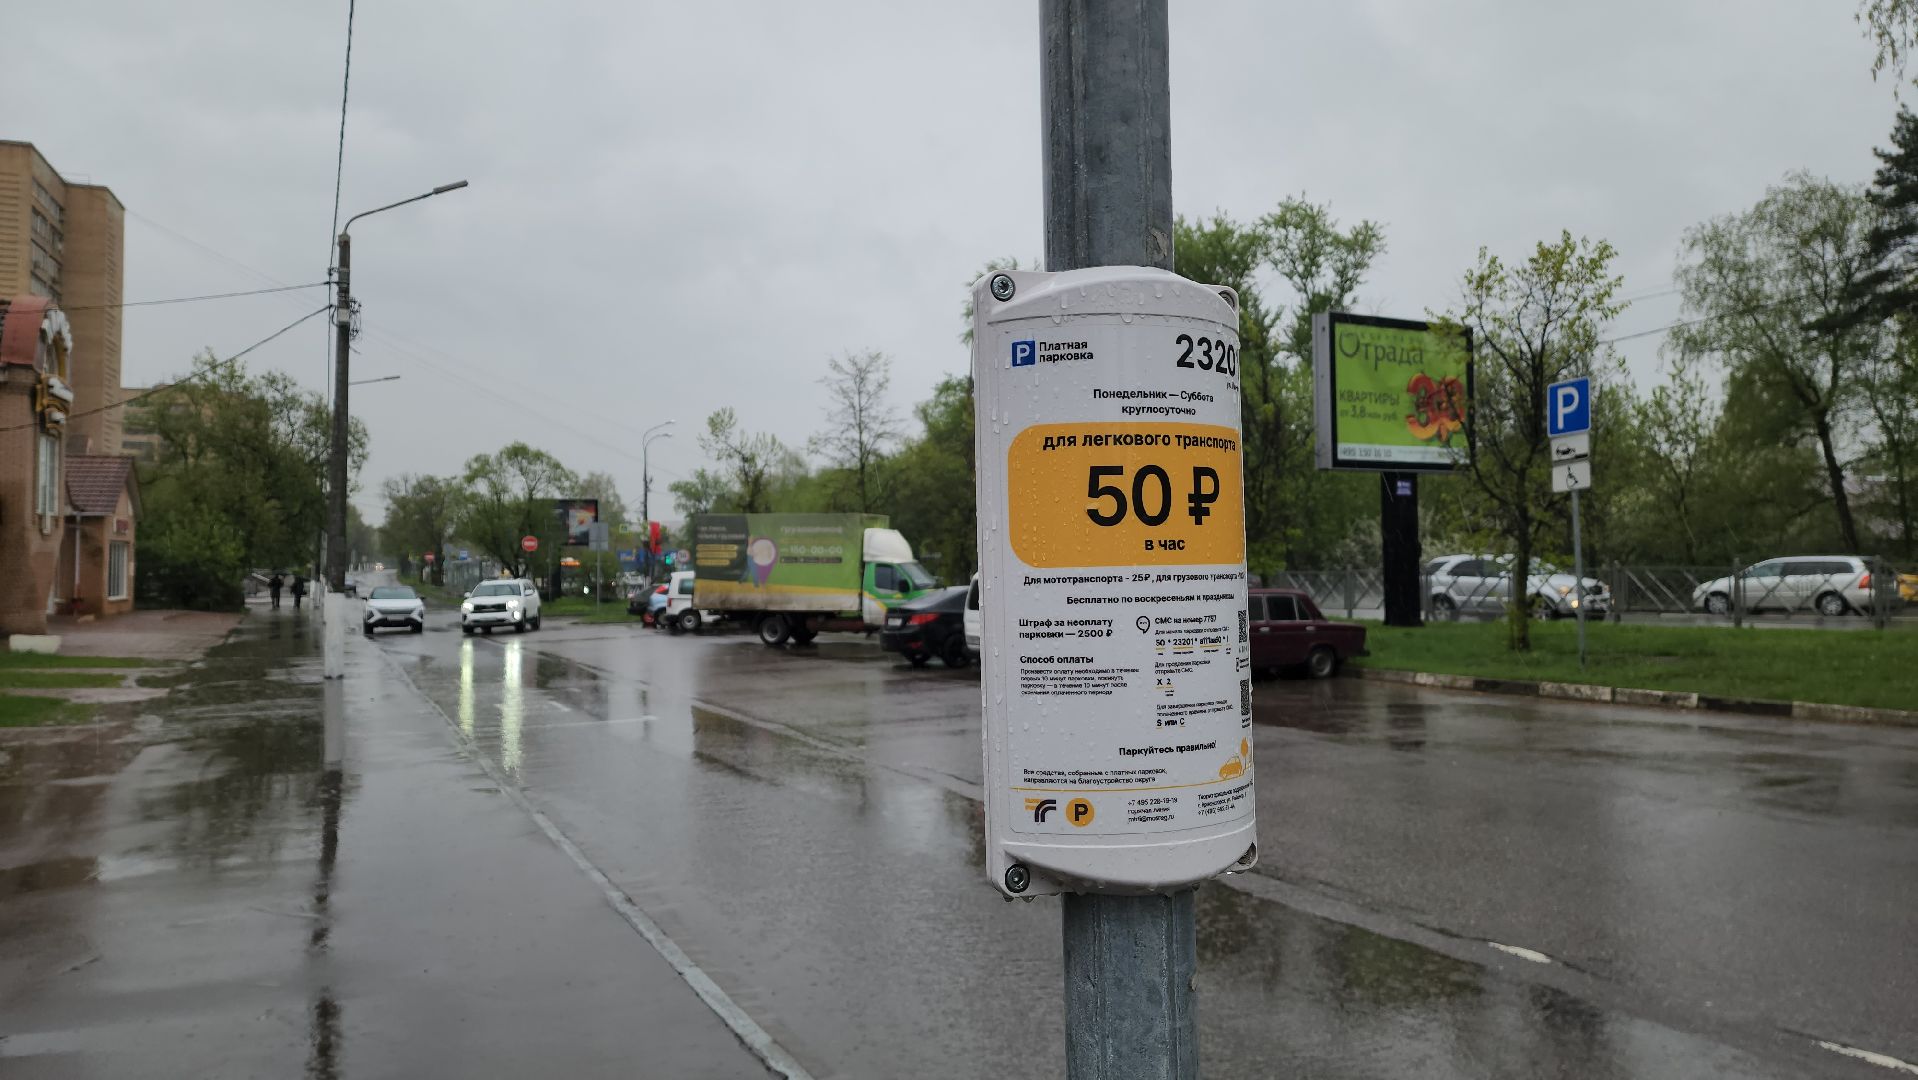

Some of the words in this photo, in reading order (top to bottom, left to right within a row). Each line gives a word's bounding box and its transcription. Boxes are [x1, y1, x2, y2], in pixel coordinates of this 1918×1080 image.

[1039, 341, 1088, 352] Платная
[1339, 330, 1424, 371] Отрада
[1039, 350, 1094, 363] парковка
[1093, 389, 1167, 401] Понедельник
[1180, 390, 1214, 403] Суббота
[1339, 390, 1399, 406] КВАРТИРЫ
[1121, 404, 1196, 417] круглосуточно
[1557, 386, 1580, 431] P
[1043, 434, 1077, 450] для
[1082, 432, 1170, 448] легкового
[1175, 434, 1236, 453] транспорта
[1086, 464, 1172, 527] 50
[1145, 540, 1154, 551] в
[1158, 539, 1186, 551] час
[1023, 576, 1042, 586] Для
[1044, 575, 1123, 585] мототранспорта
[1156, 574, 1171, 583] для
[1066, 596, 1119, 605] Бесплатно
[1135, 595, 1194, 604] воскресеньям
[1019, 619, 1052, 628] Штраф
[1067, 619, 1113, 628] неоплату
[1155, 616, 1173, 625] СМС
[1019, 631, 1064, 640] парковки
[1078, 629, 1103, 638] 2500
[1155, 639, 1165, 647] 50
[1020, 655, 1055, 664] Способ
[1057, 656, 1094, 664] оплаты
[1119, 746, 1174, 757] Паркуйтесь
[1176, 740, 1217, 753] правильно!
